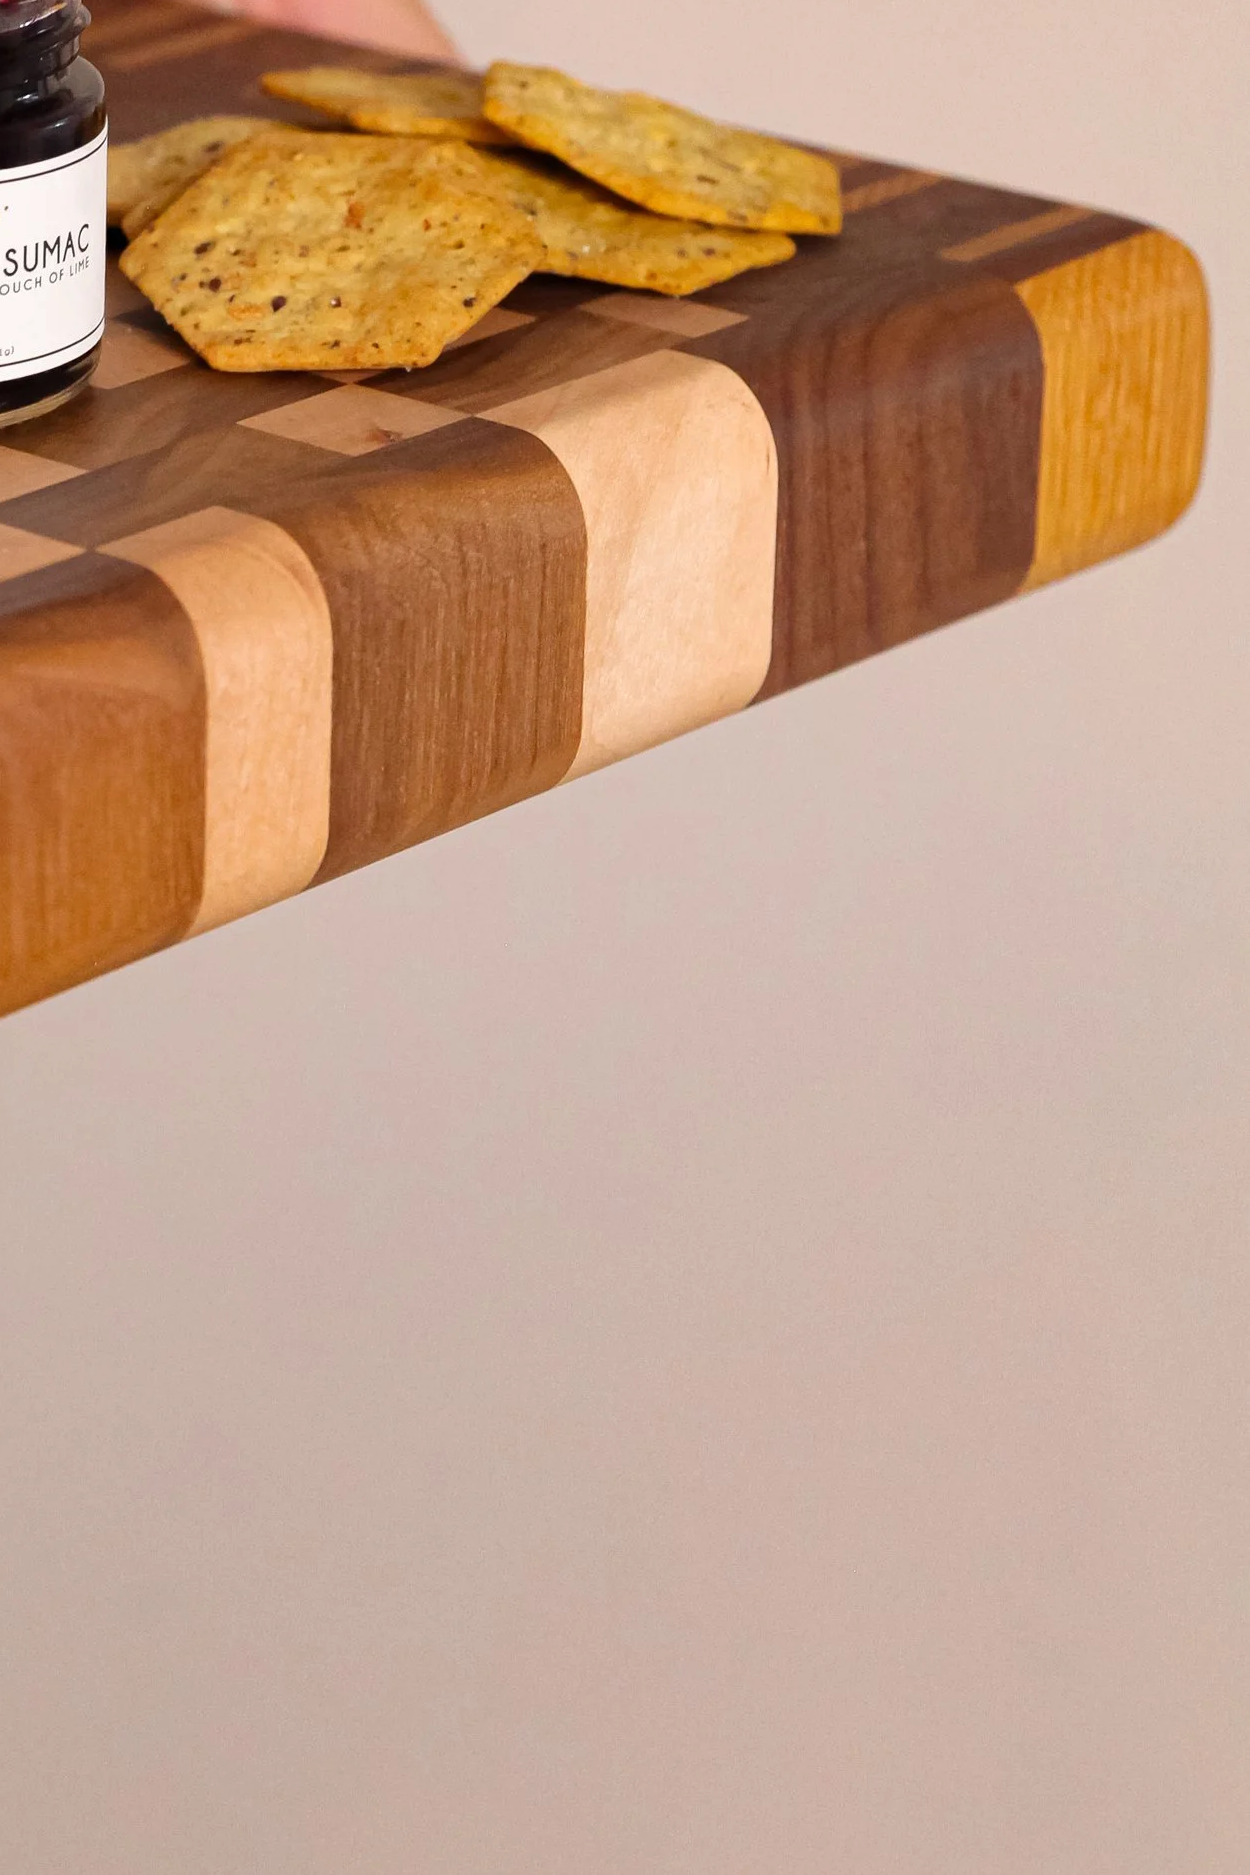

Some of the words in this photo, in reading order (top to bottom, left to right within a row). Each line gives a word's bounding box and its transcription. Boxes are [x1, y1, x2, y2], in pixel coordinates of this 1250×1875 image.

[3, 223, 90, 277] SUMAC
[49, 268, 65, 284] OF
[69, 255, 90, 277] LIME
